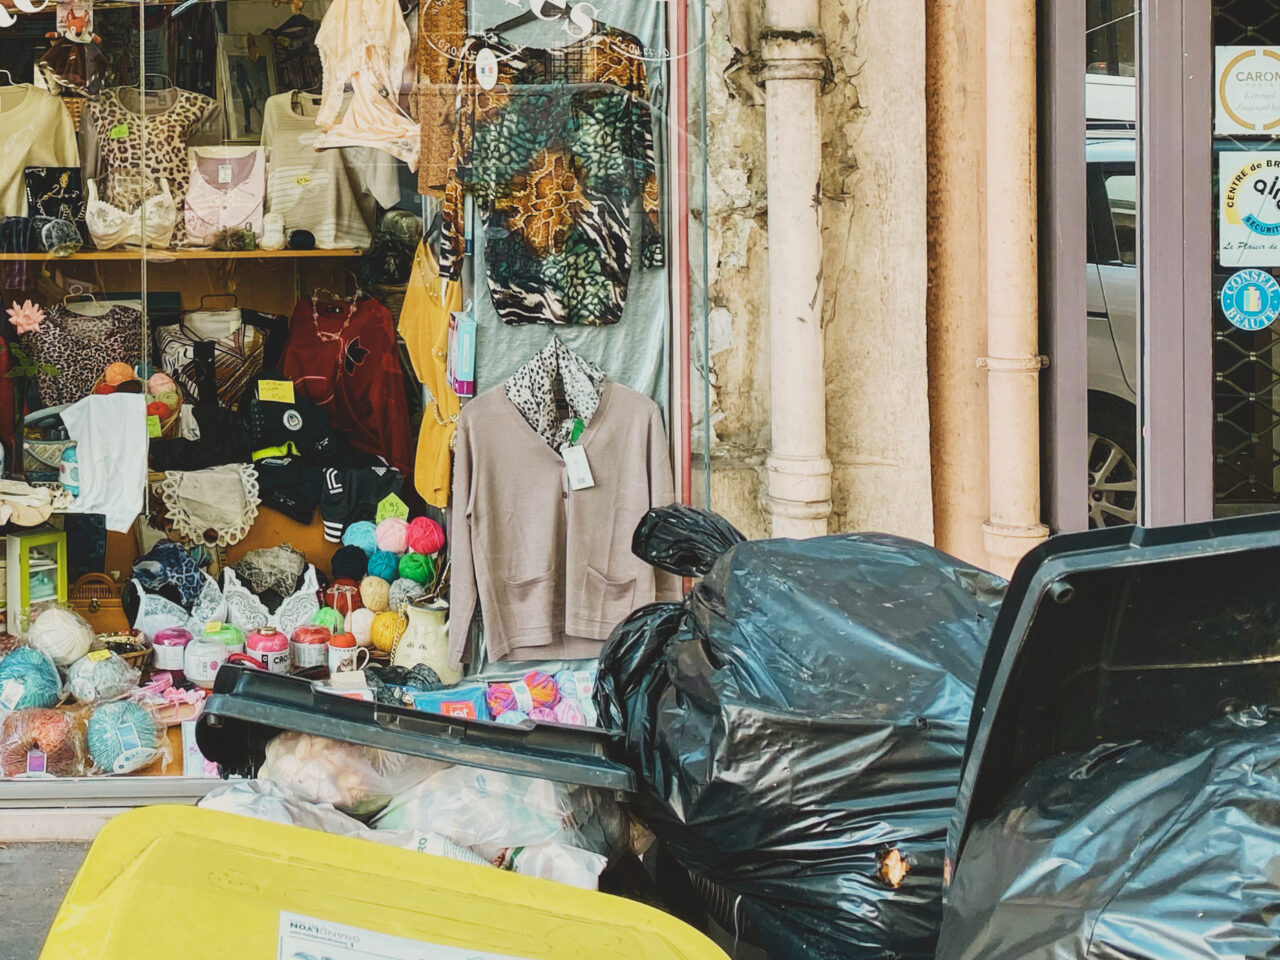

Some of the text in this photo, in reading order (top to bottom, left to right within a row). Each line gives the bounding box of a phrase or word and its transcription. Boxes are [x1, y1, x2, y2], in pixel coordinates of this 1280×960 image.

[1227, 169, 1248, 208] CENTRE
[1250, 162, 1263, 172] de
[1222, 241, 1234, 250] Le
[1237, 241, 1266, 250] Plaisir
[1225, 270, 1277, 297] CONSEIL
